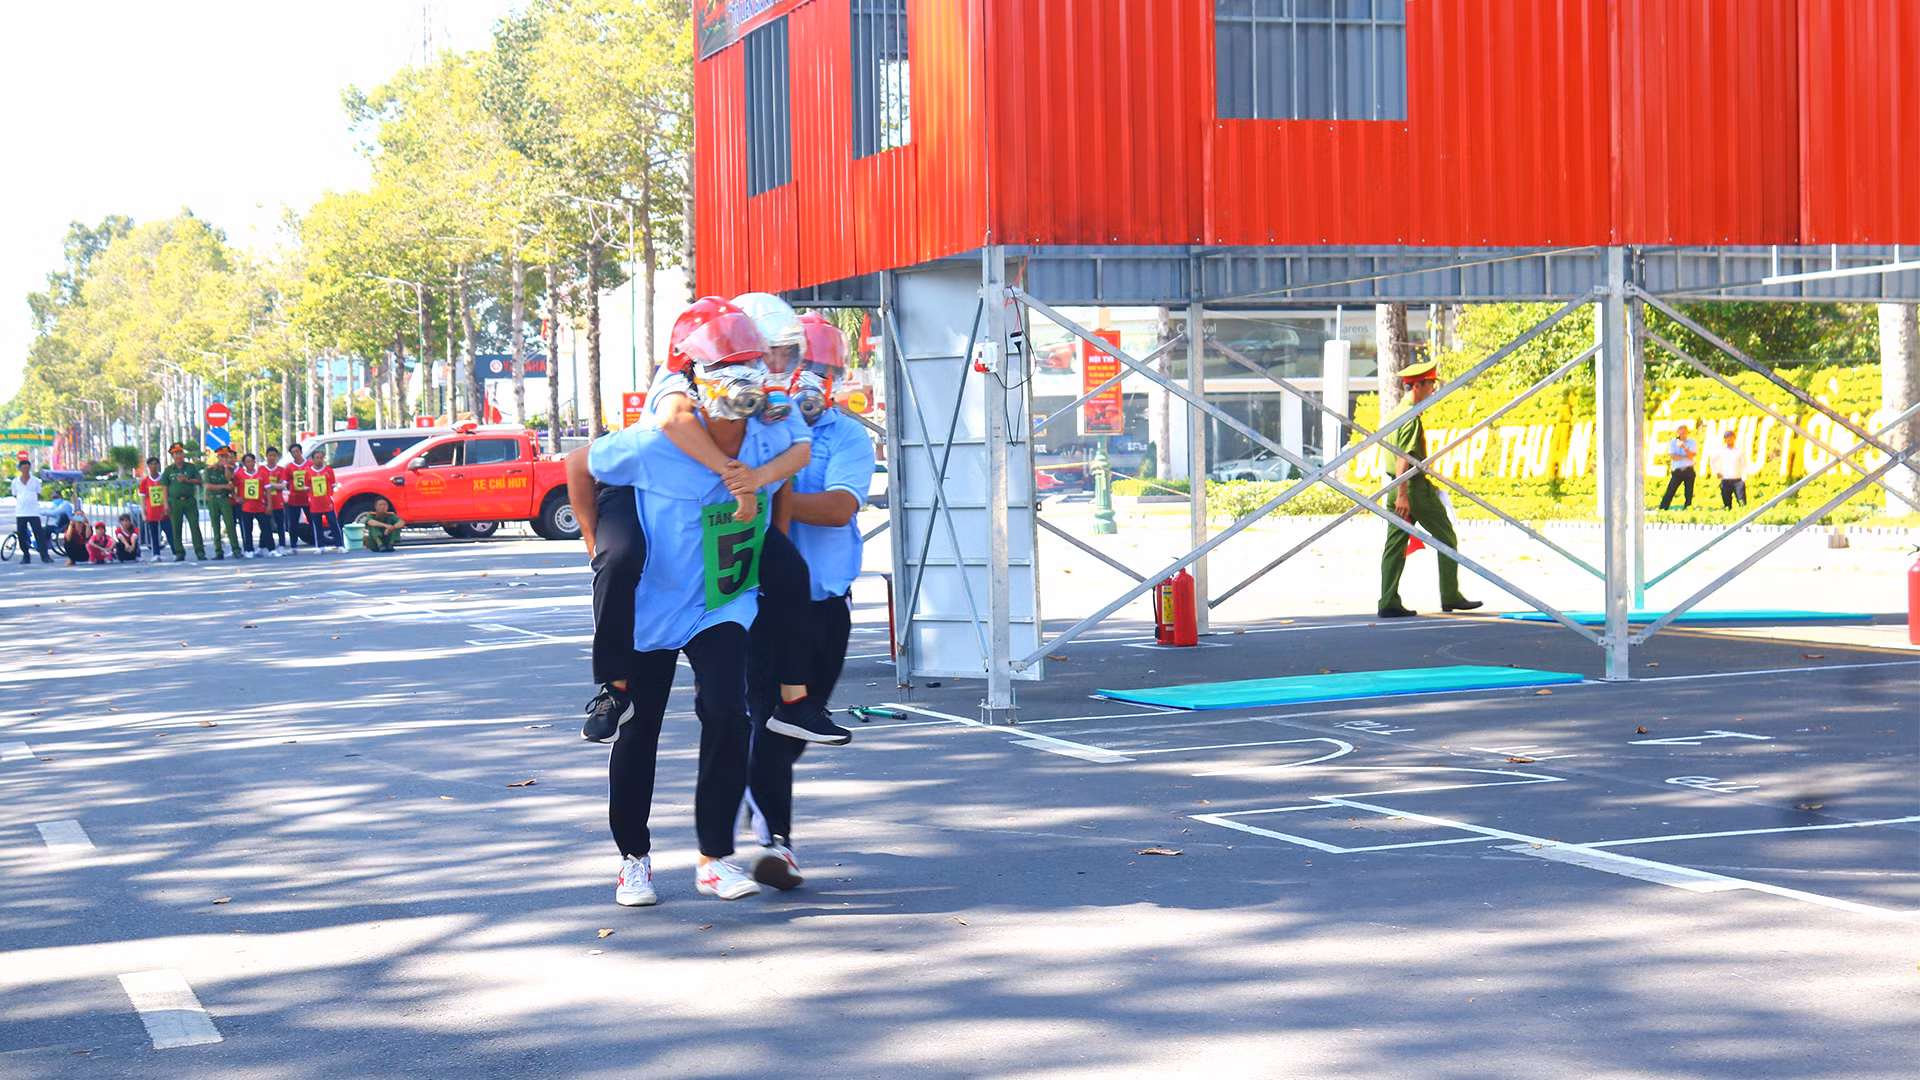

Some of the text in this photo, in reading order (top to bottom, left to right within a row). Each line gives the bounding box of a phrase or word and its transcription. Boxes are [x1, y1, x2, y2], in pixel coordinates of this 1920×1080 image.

[296, 477, 305, 488] 5
[473, 479, 487, 491] XE
[507, 477, 528, 489] HUY
[247, 485, 256, 497] 6
[317, 483, 323, 494] 1
[152, 493, 161, 504] 2
[717, 526, 756, 596] 5
